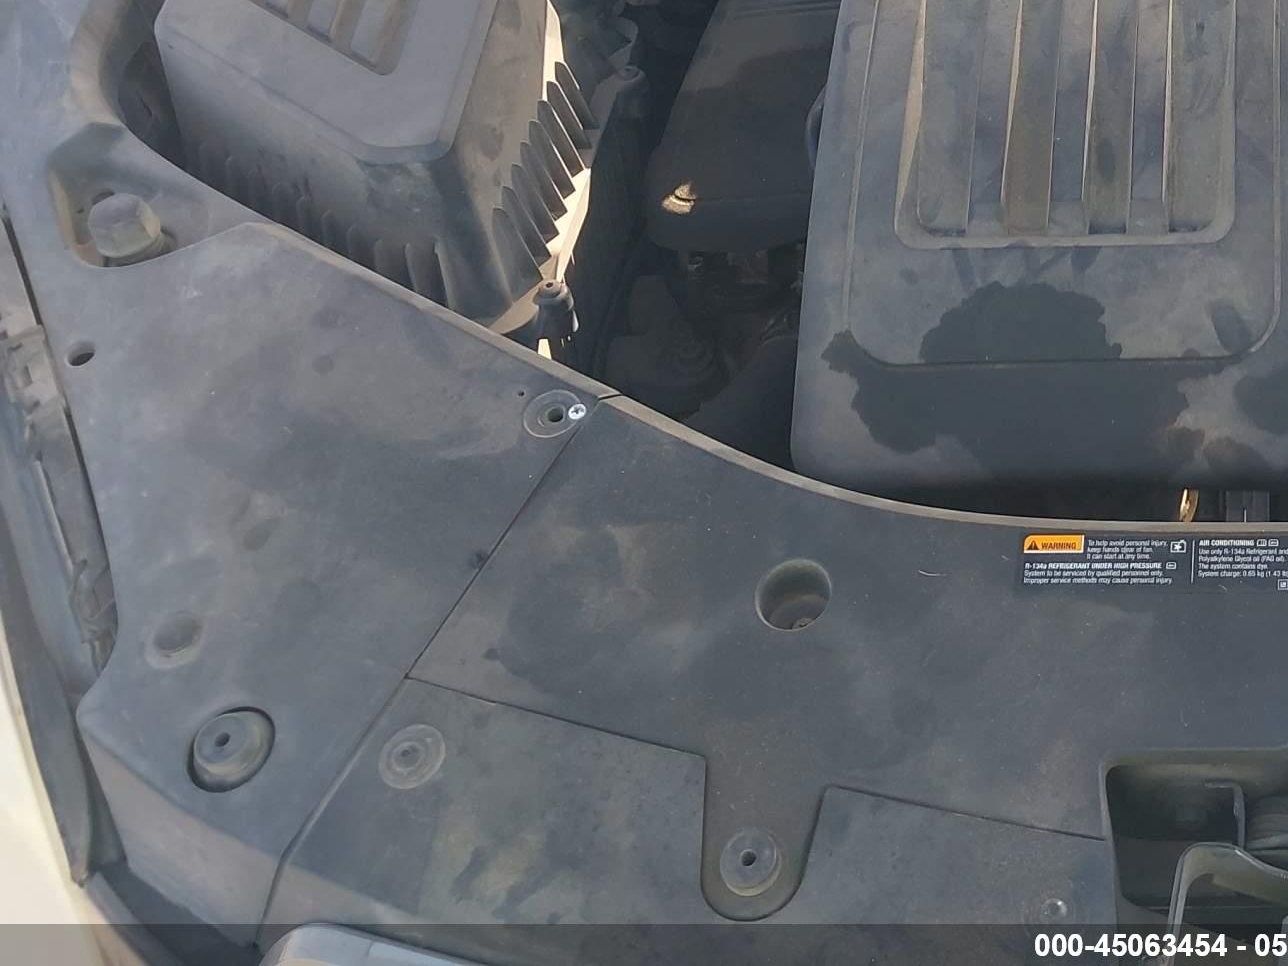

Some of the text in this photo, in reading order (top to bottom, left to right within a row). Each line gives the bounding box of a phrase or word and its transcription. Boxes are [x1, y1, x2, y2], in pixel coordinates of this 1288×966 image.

[1041, 542, 1076, 550] WARNING
[1095, 540, 1108, 548] help
[1125, 540, 1150, 548] personal
